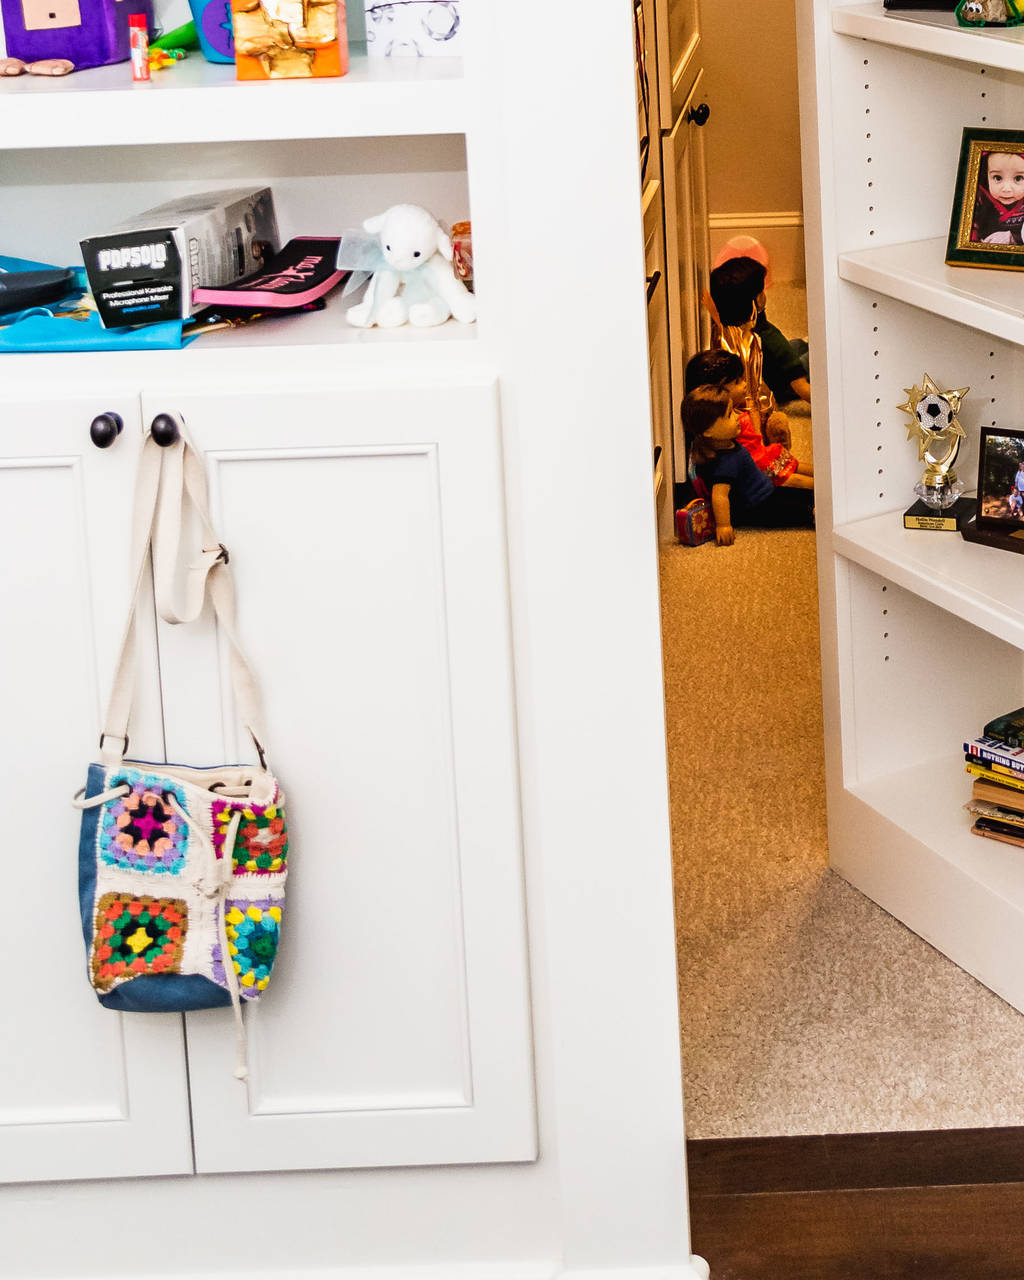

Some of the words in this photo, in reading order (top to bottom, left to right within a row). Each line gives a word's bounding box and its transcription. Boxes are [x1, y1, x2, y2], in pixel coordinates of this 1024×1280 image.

[102, 288, 145, 299] Professional
[145, 285, 174, 294] Karaoke
[109, 296, 150, 307] Microphone
[150, 293, 170, 302] Mixer
[982, 751, 1010, 765] NOTHING
[1011, 761, 1023, 769] BUT
